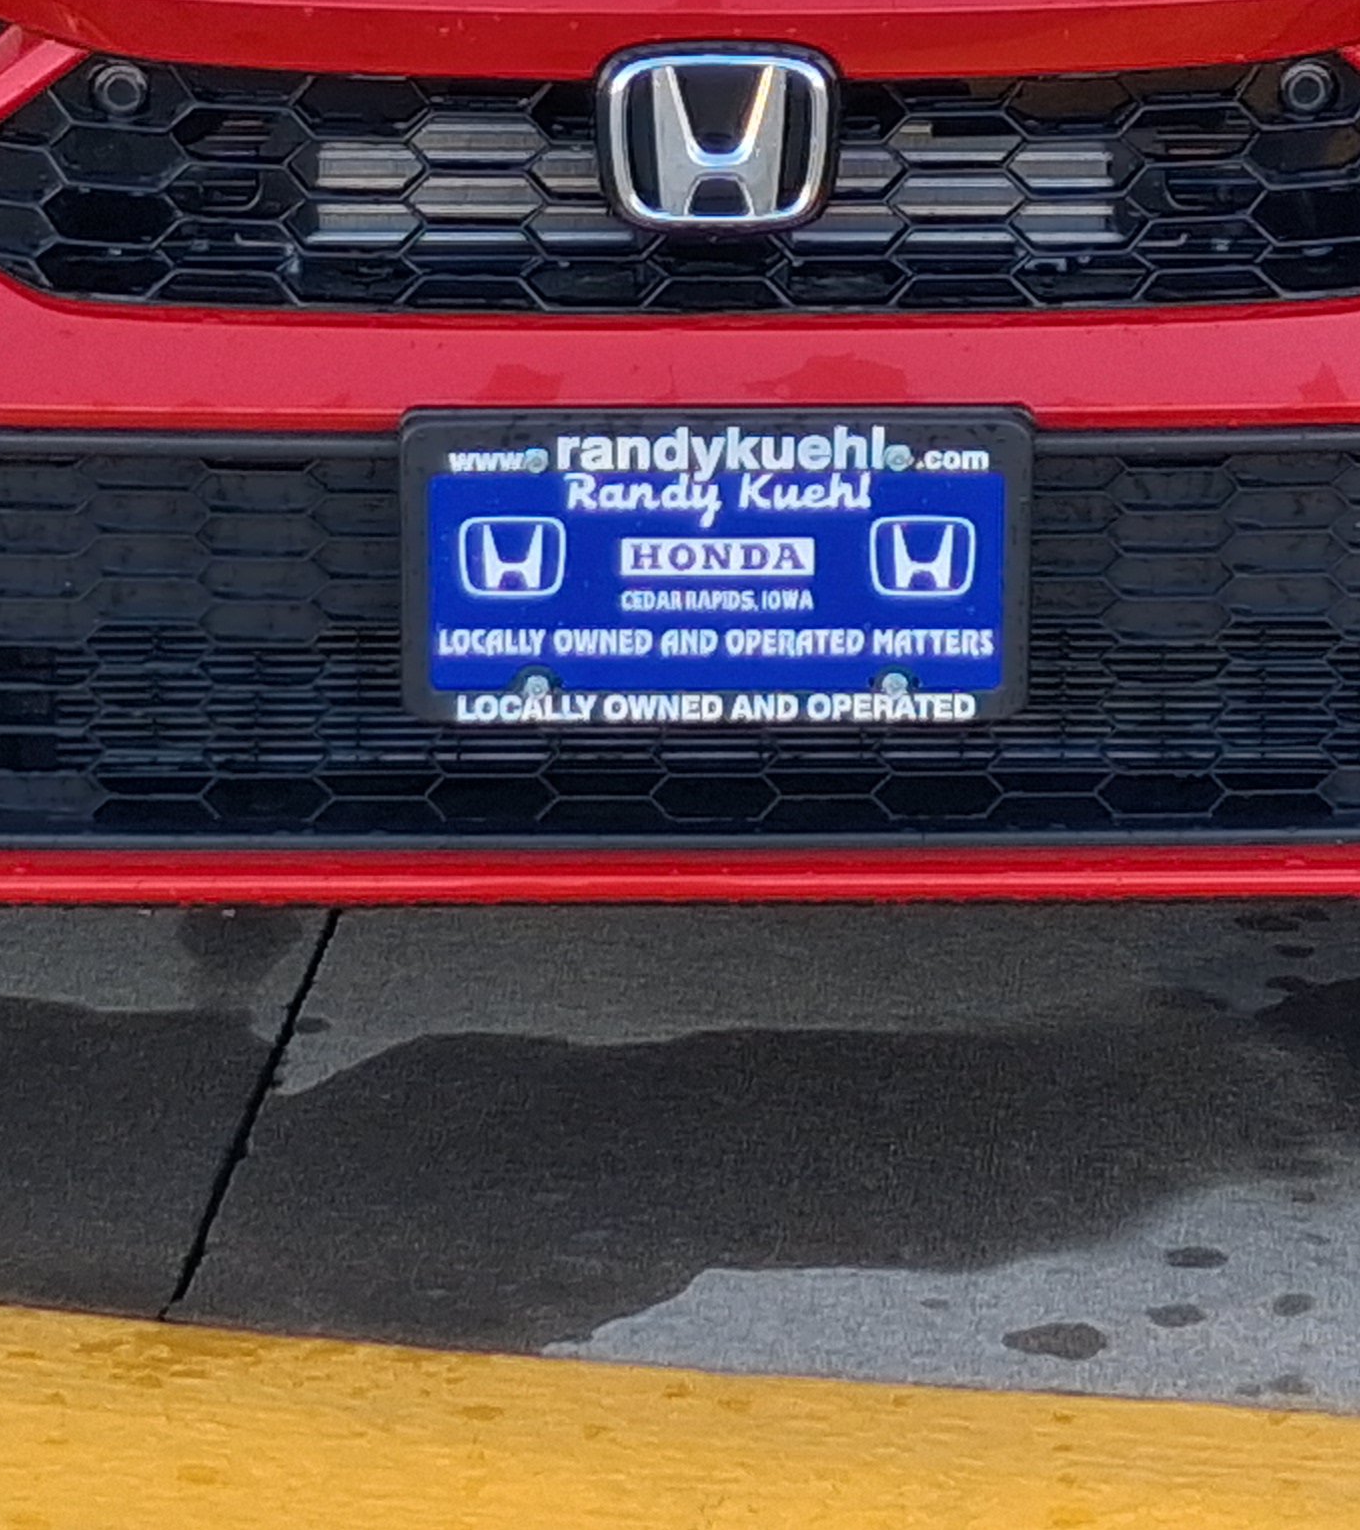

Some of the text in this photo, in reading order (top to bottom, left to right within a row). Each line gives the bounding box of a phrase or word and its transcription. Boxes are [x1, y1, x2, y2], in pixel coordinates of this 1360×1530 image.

[562, 472, 872, 528] Randy Kuehl
[630, 542, 806, 571] HONDA
[620, 589, 682, 612] CEDAR
[761, 589, 815, 611] IOWA
[439, 627, 995, 658] LOCALLY OWNED AND OPERATED MATTERS
[456, 693, 977, 722] LOCALLY OWNED AND OPERATED
